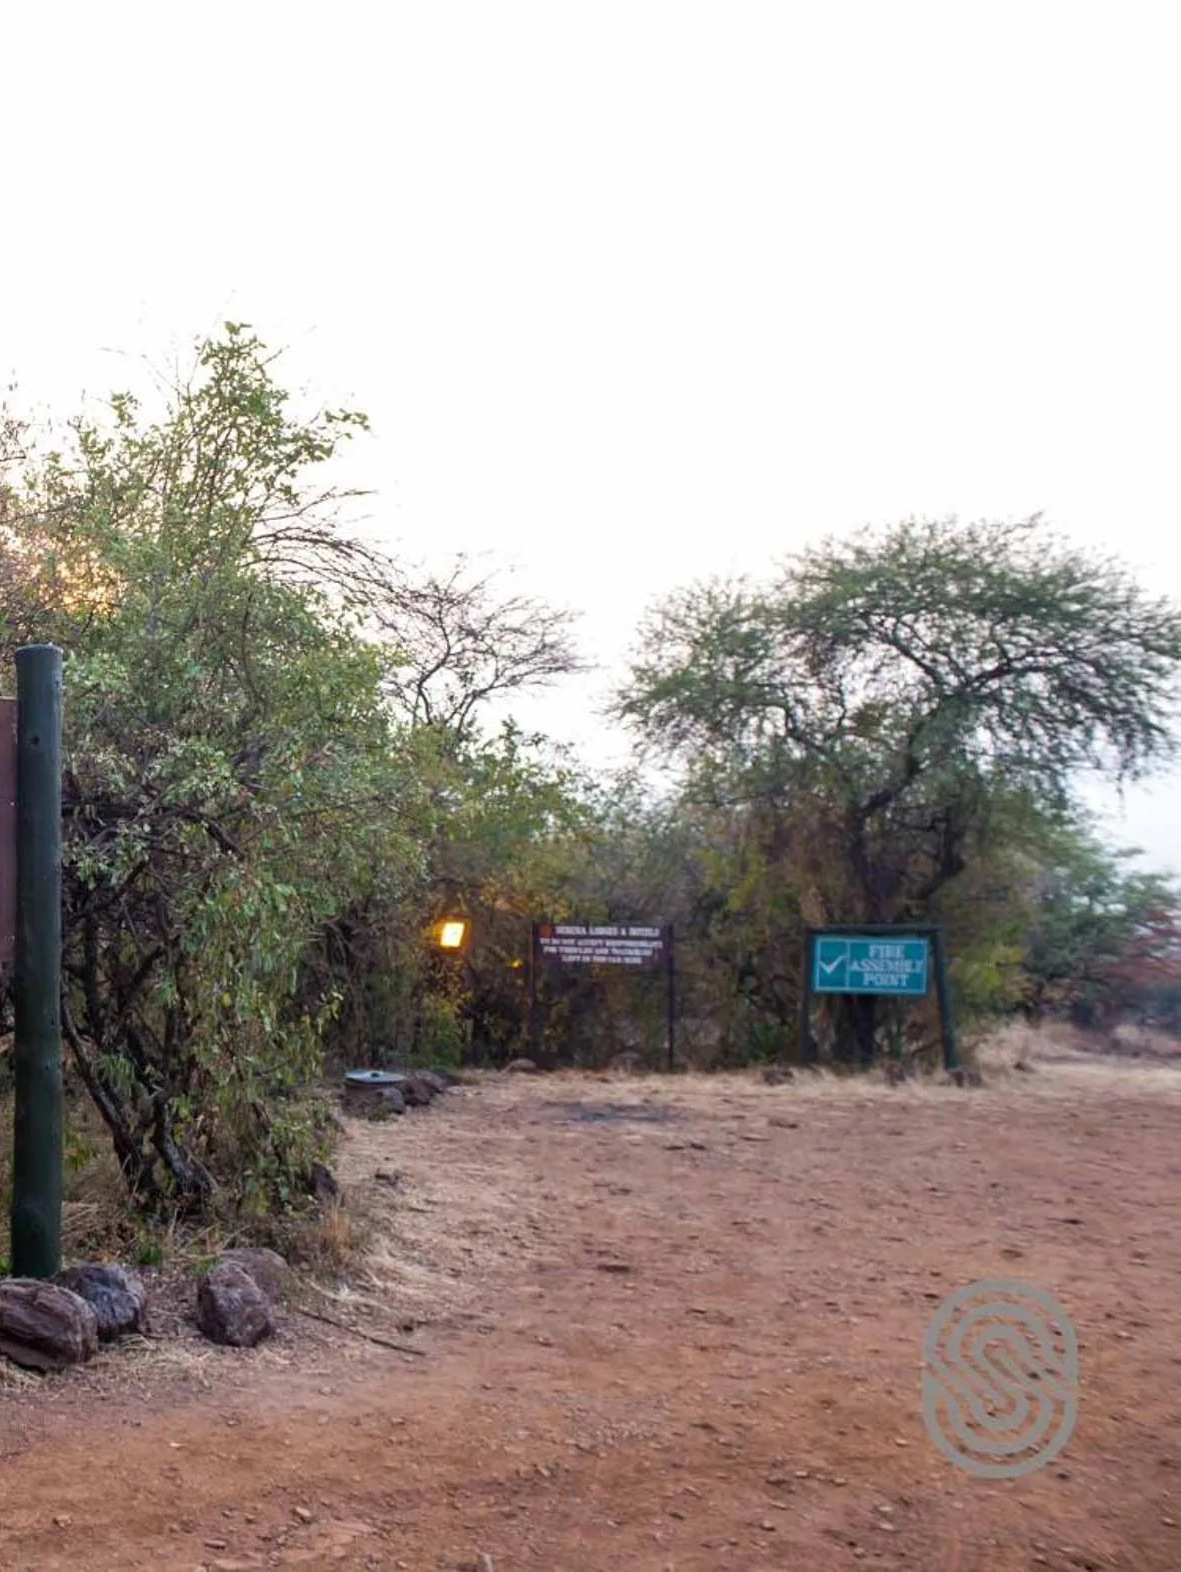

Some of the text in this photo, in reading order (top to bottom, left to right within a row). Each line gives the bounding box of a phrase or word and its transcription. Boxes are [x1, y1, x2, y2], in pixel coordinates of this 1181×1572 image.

[869, 944, 906, 958] FIRE
[850, 958, 924, 973] ASSEMBLY
[862, 973, 911, 988] POINT
